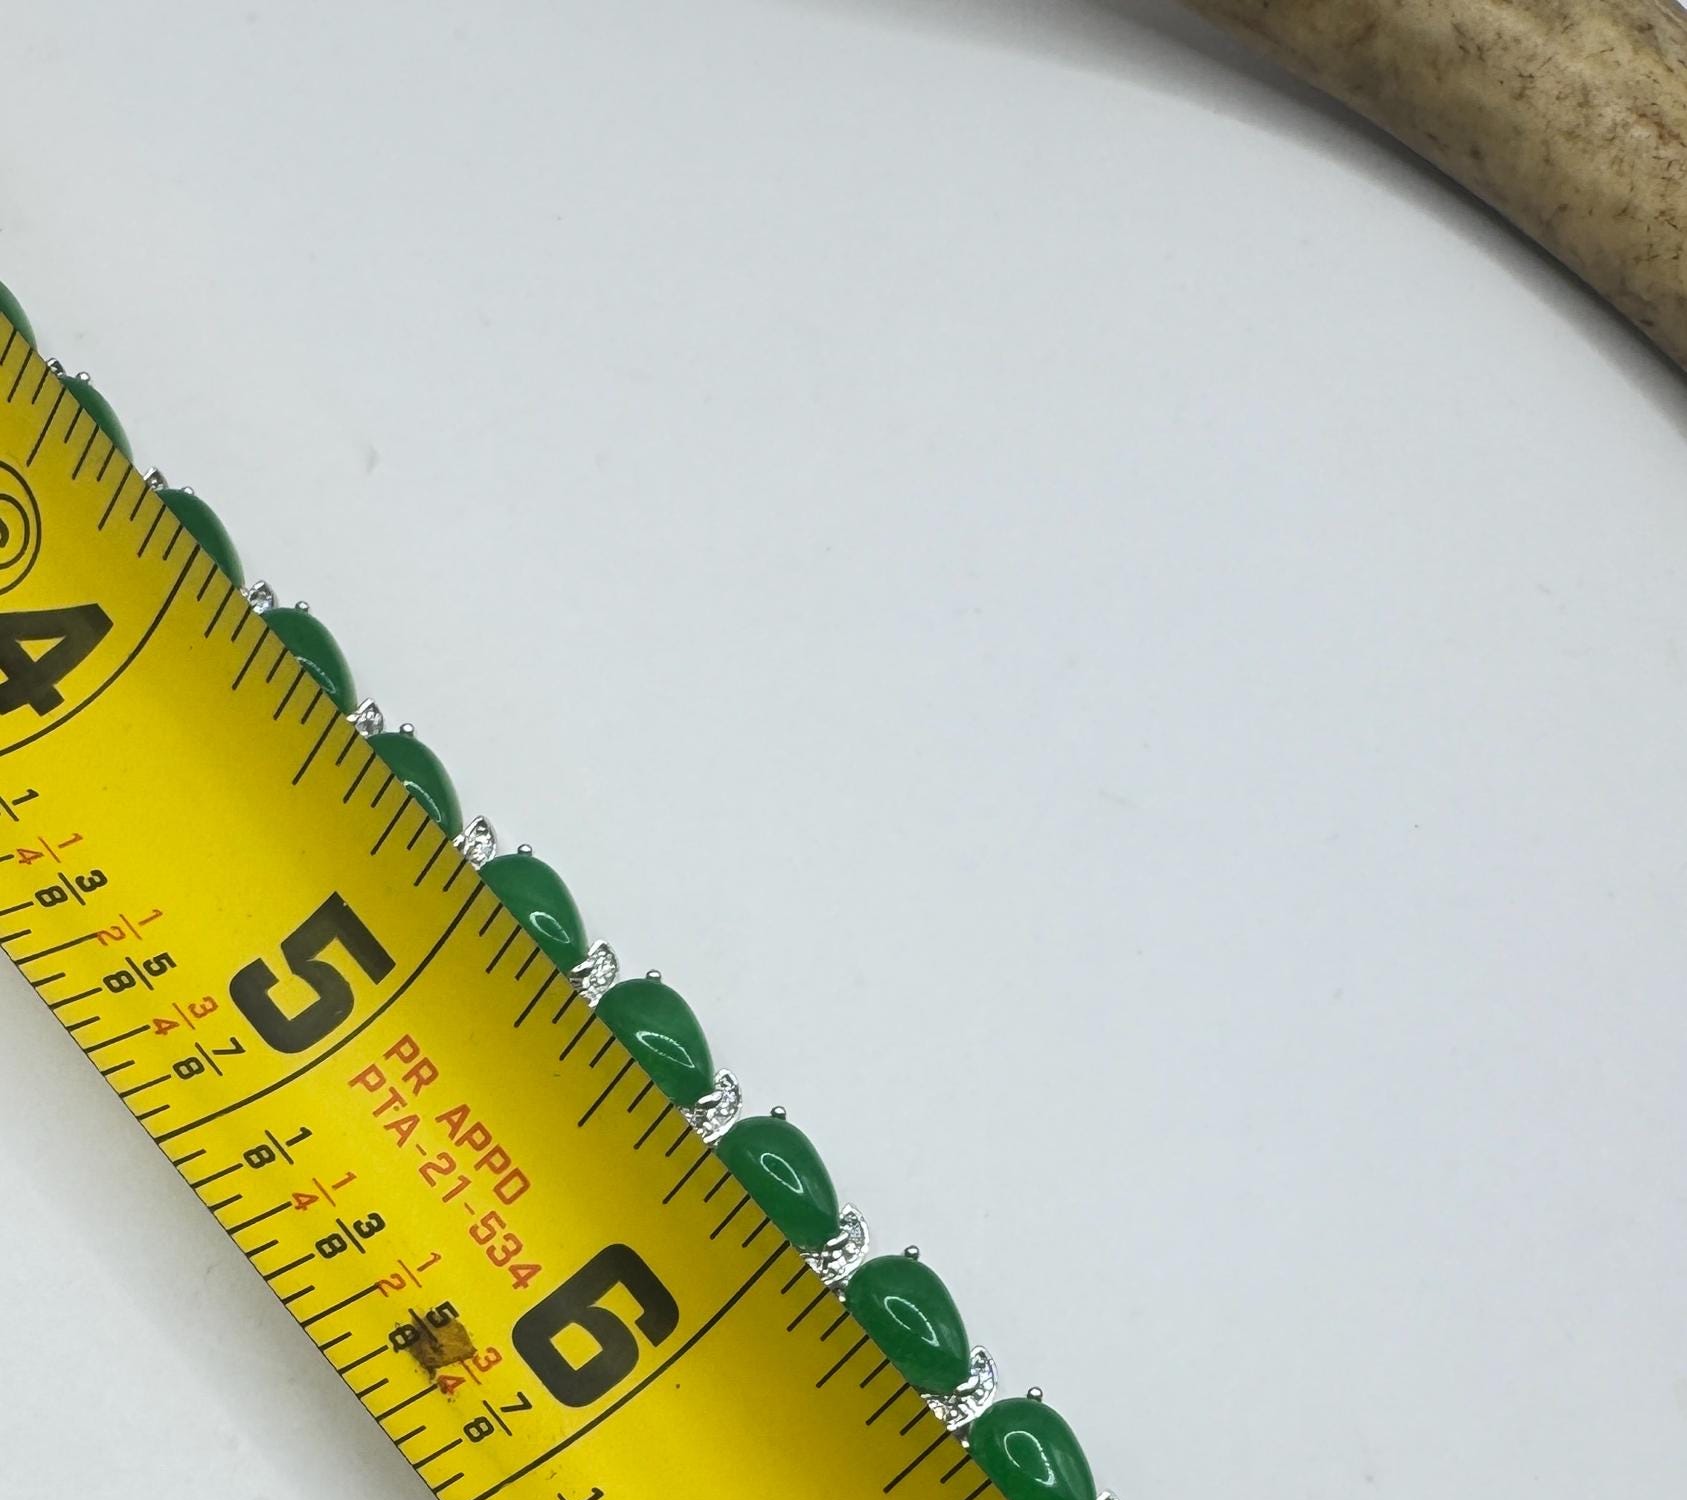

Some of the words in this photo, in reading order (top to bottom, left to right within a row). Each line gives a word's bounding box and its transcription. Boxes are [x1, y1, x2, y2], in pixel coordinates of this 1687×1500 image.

[0, 603, 114, 716] 4
[229, 890, 396, 1054] 5
[347, 1064, 542, 1290] PTA-21-534
[382, 1034, 440, 1097] PR
[435, 1103, 532, 1206] APPD
[512, 1243, 680, 1408] 6
